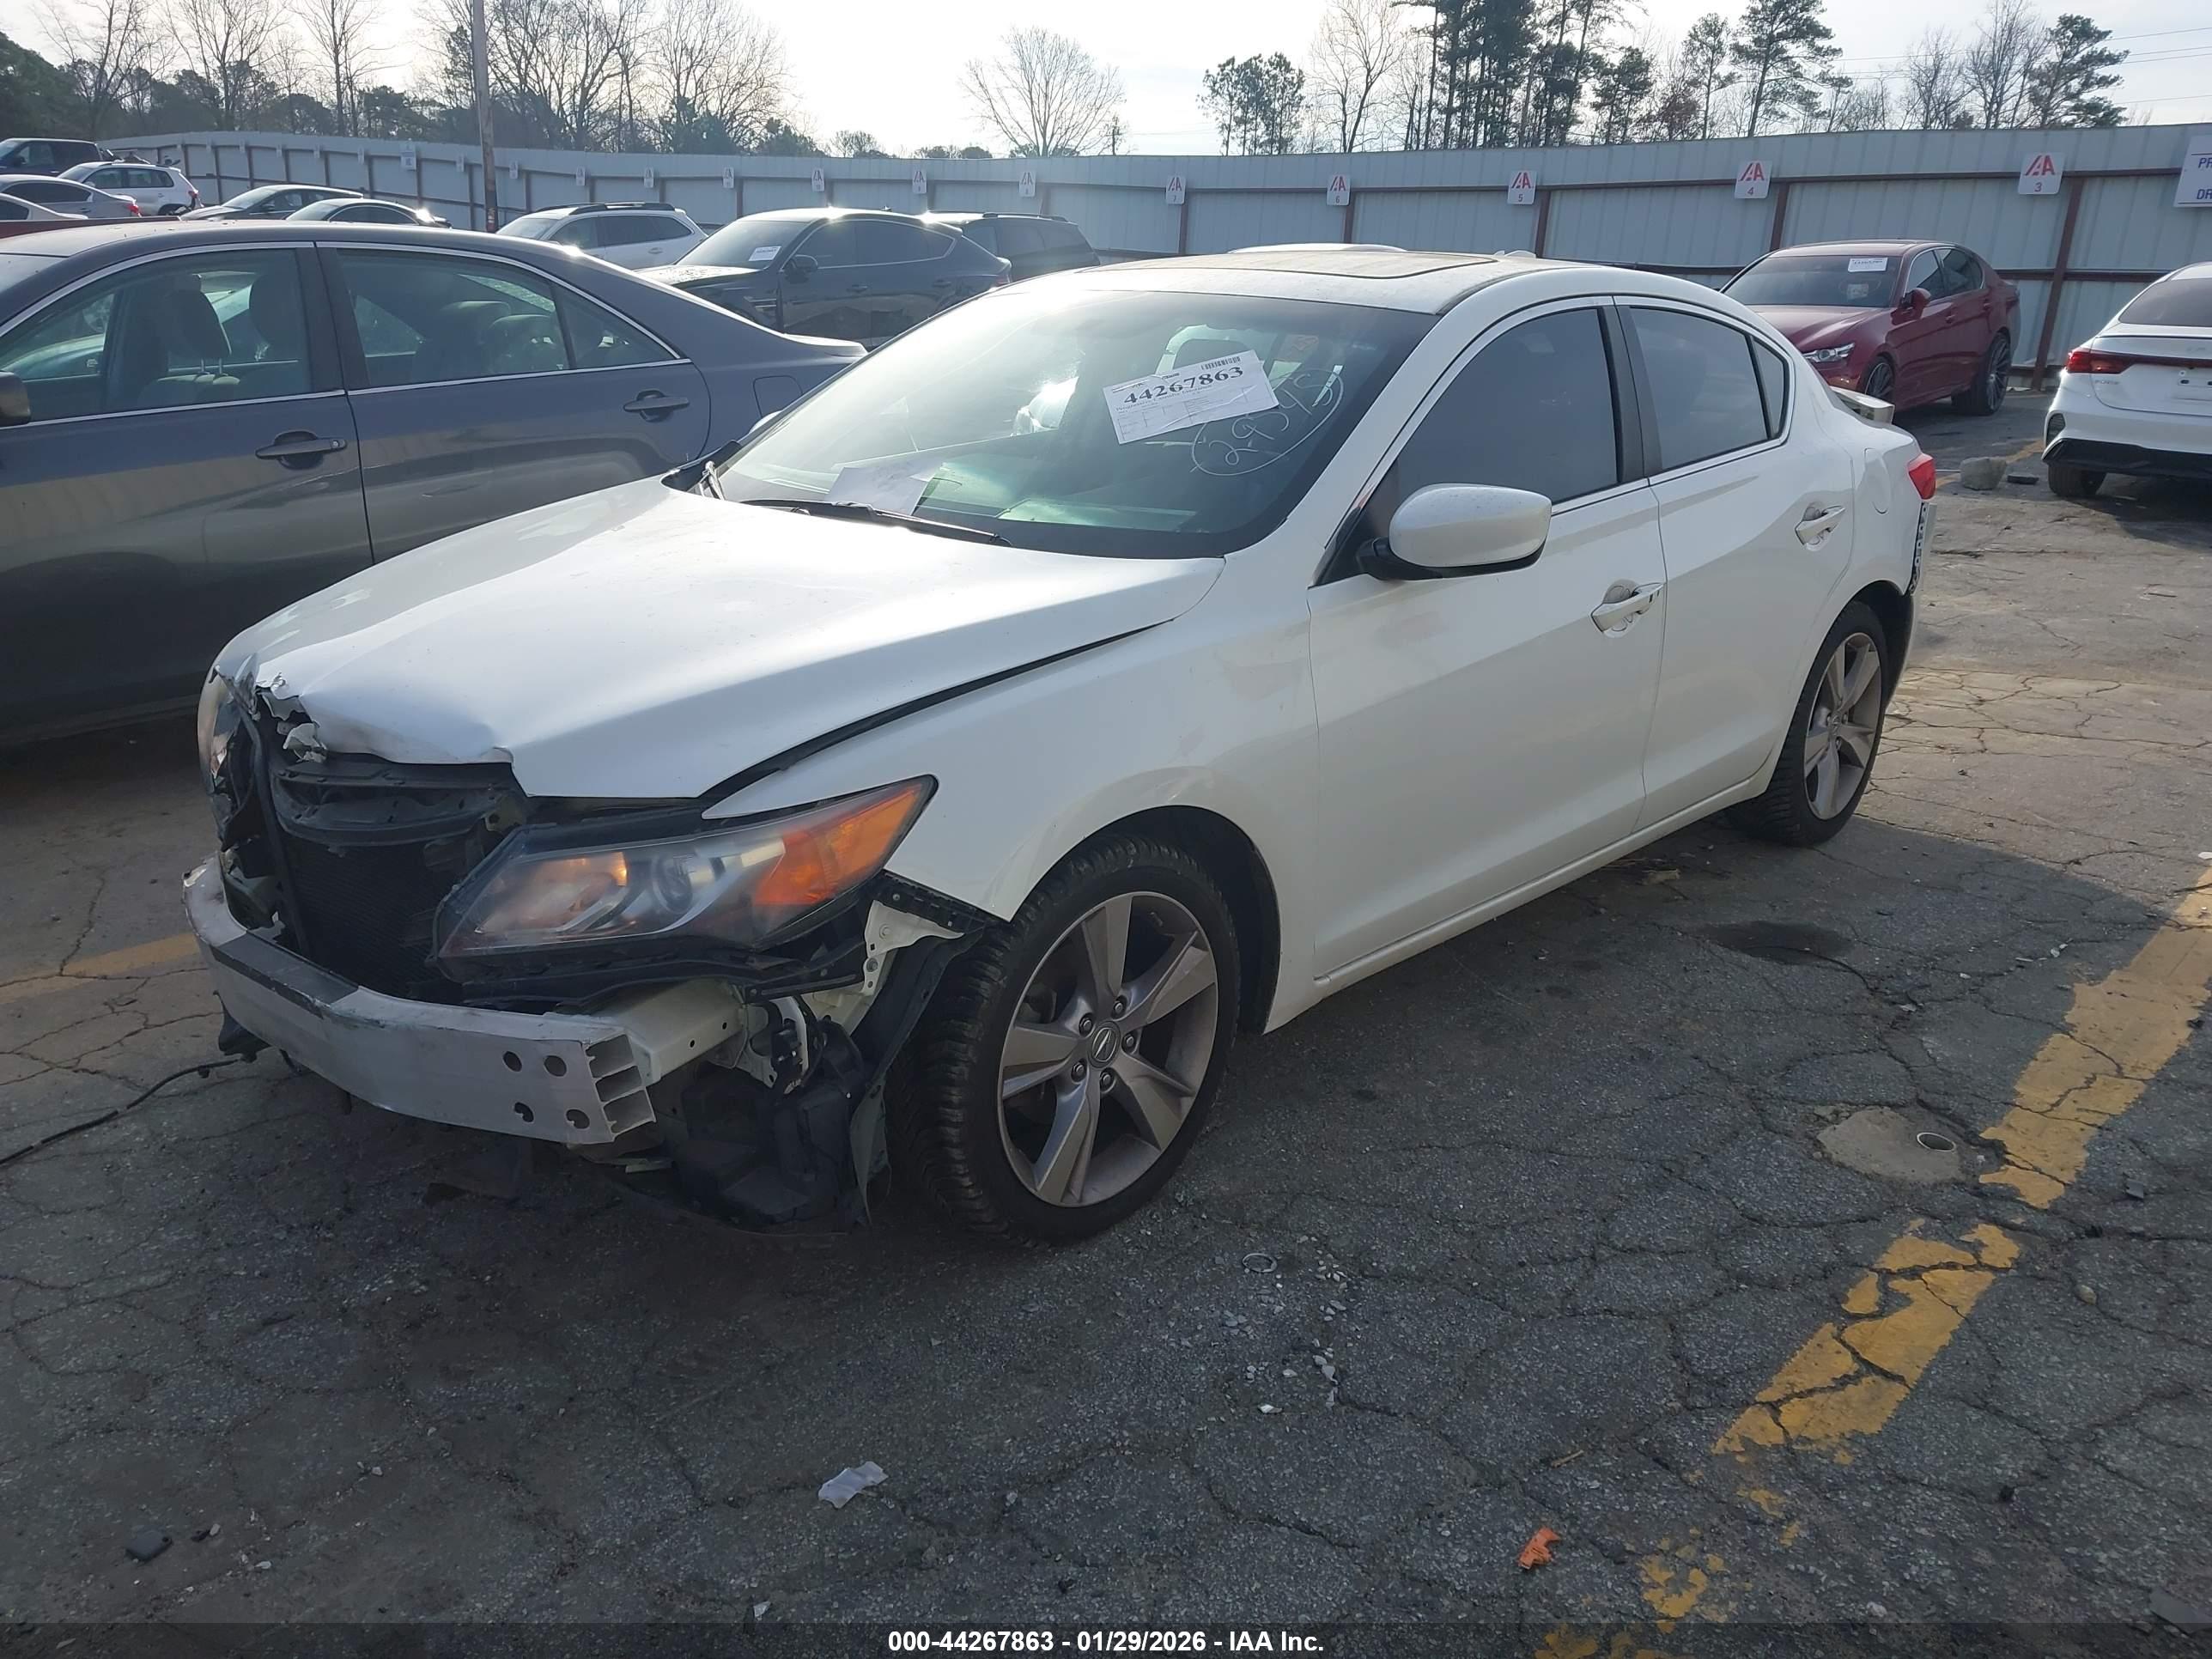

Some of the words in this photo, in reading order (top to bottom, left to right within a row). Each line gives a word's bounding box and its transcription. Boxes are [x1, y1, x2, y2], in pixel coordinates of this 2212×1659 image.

[1747, 186, 1754, 197] 4
[2033, 182, 2042, 192] 3
[1518, 193, 1524, 203] 5
[1123, 366, 1243, 404] 44267863
